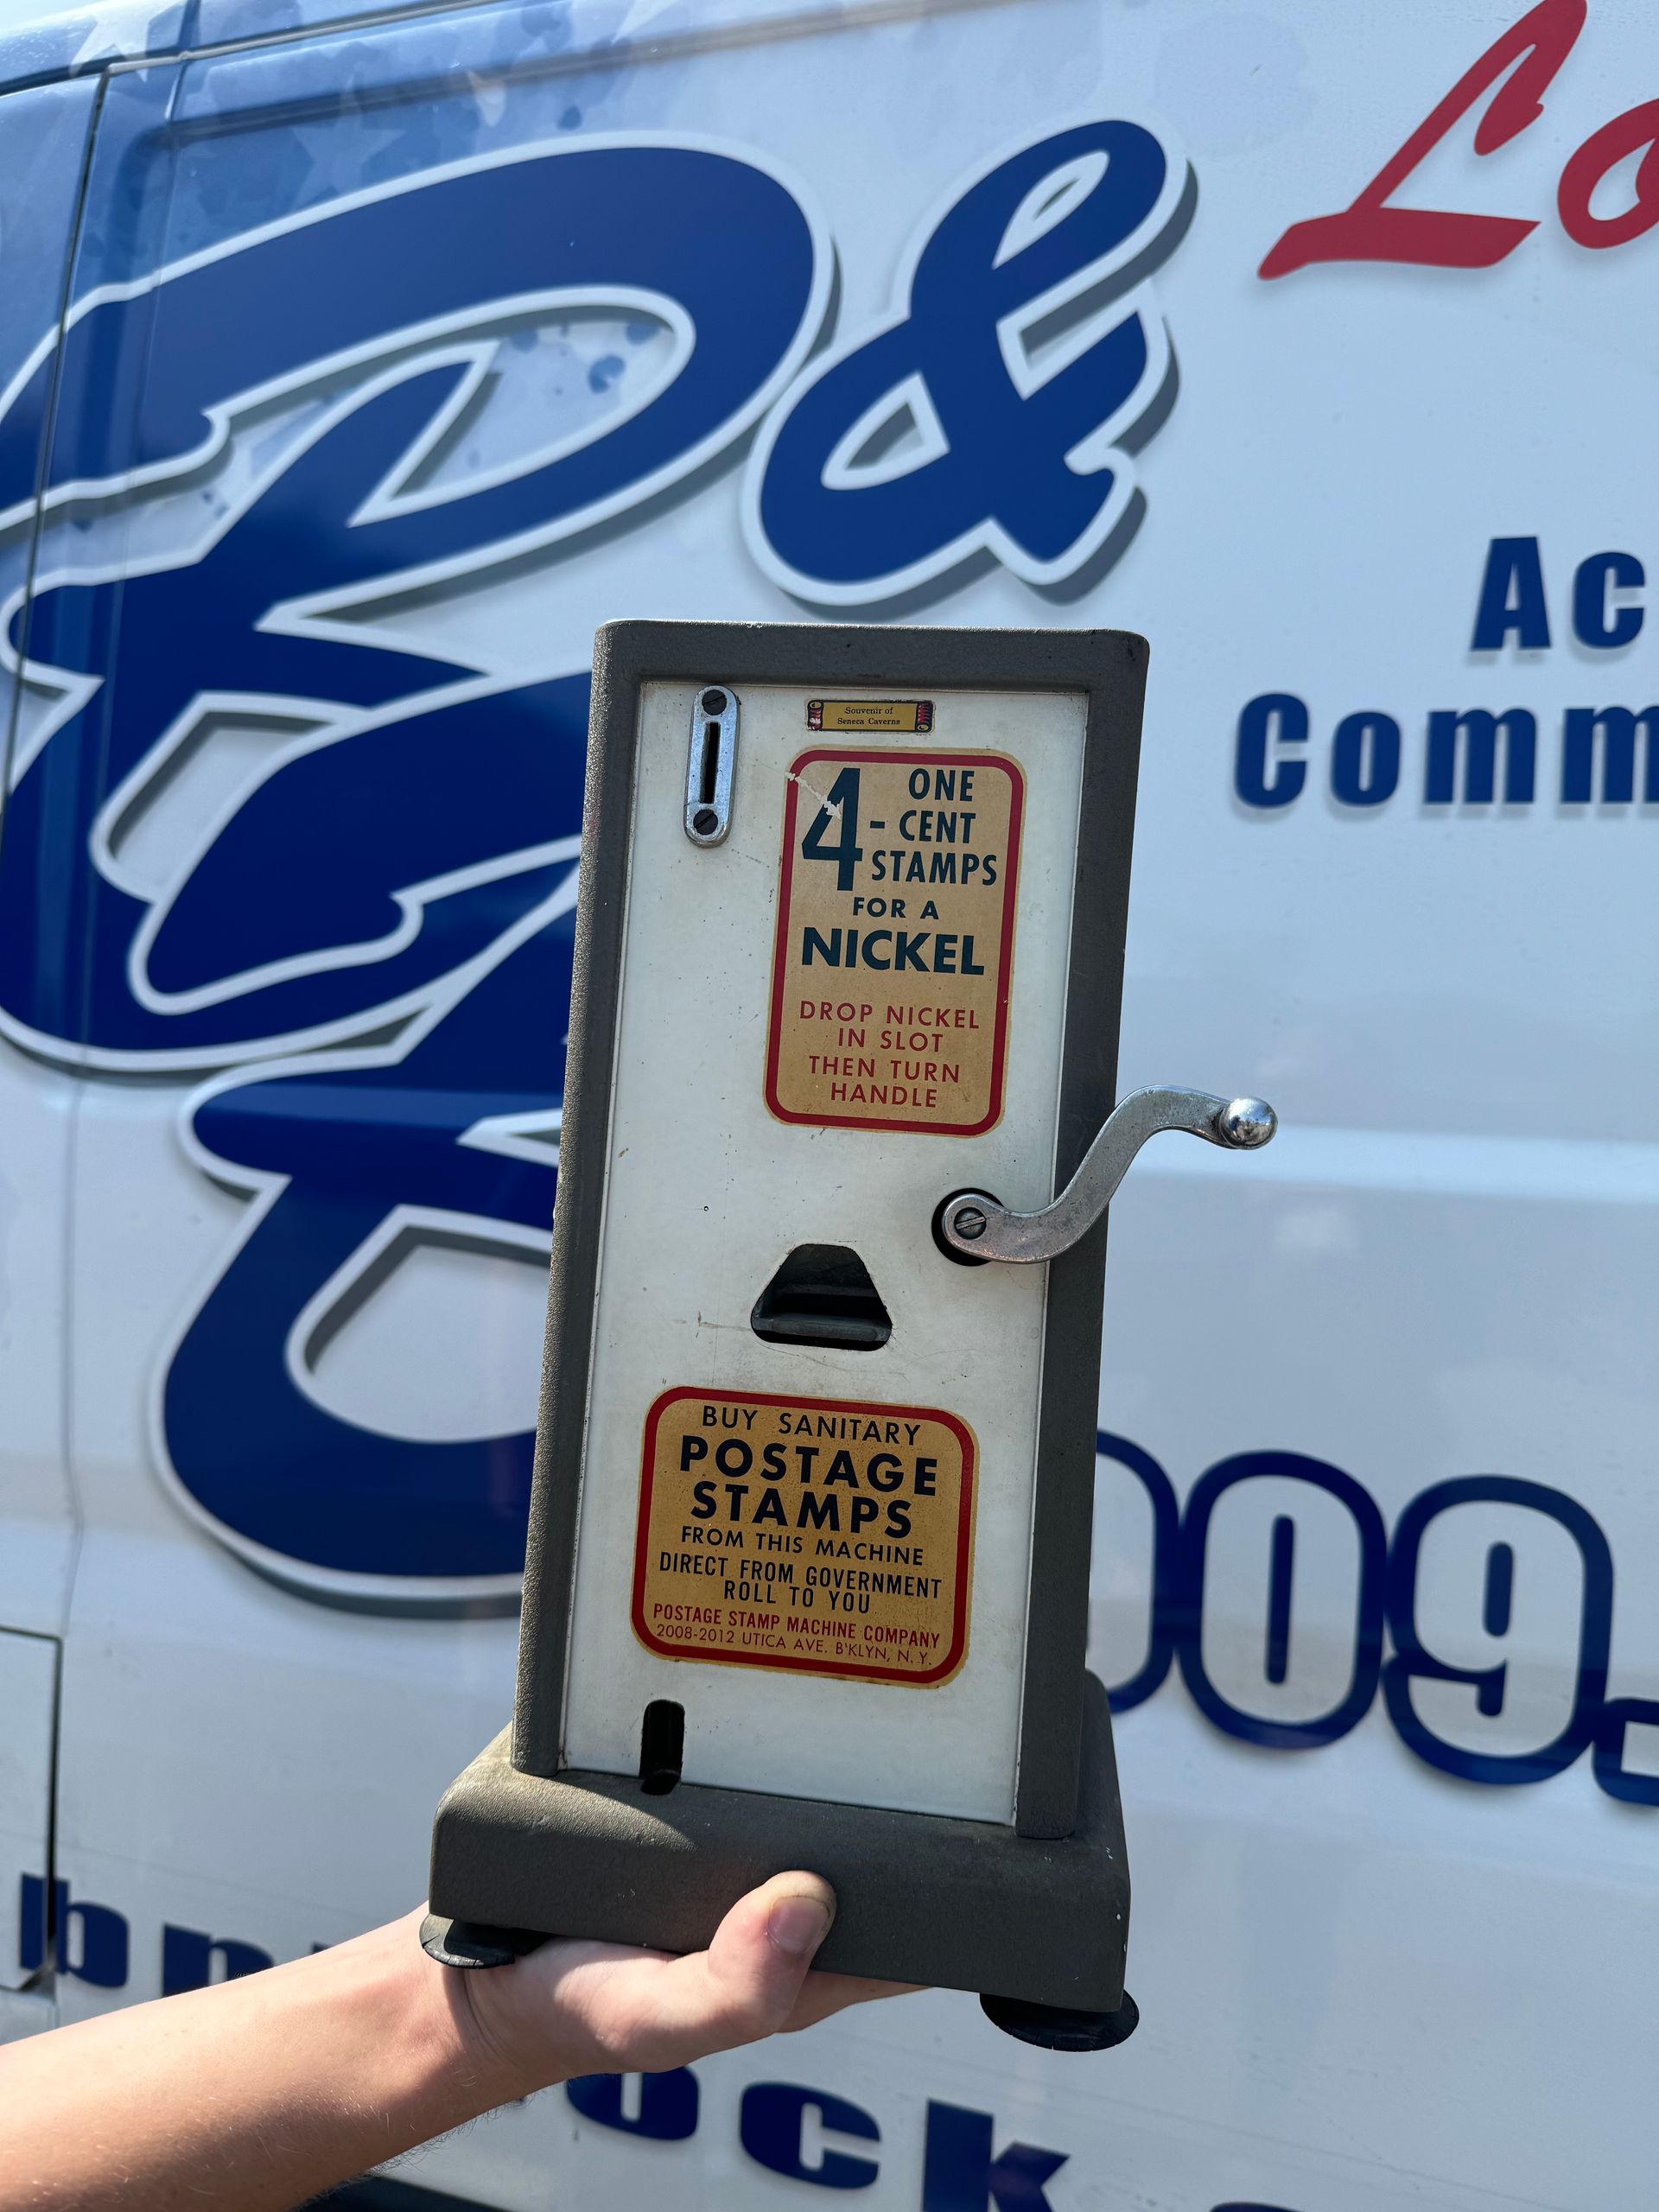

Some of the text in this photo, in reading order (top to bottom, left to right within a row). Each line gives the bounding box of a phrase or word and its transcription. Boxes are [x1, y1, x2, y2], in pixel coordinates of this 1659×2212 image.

[1233, 691, 1659, 809] Comm
[908, 768, 976, 802] ONE
[899, 810, 976, 844] CENT
[872, 850, 997, 886] STAMPS
[853, 897, 939, 920] FOR A
[802, 927, 984, 975] NICKEL
[800, 1001, 980, 1029] DROP NICKEL
[838, 1027, 944, 1052] IN SLOT
[809, 1056, 960, 1084] THEN TURN
[831, 1083, 938, 1108] HANDLE
[702, 1406, 921, 1446] BUY SANITARY
[679, 1435, 938, 1496] POSTAGE
[691, 1481, 912, 1538] STAMPS
[681, 1526, 923, 1566] FROM THIS MACHINE
[660, 1552, 942, 1599] DIRECT FROM GOVERNMENT
[724, 1580, 870, 1614] ROLL TO YOU
[653, 1604, 940, 1649] POSTAGE STAMP MACHINE COMPANY
[657, 1624, 734, 1643] 2008-2012
[742, 1632, 786, 1648] UTICA
[793, 1637, 827, 1654] AVE.
